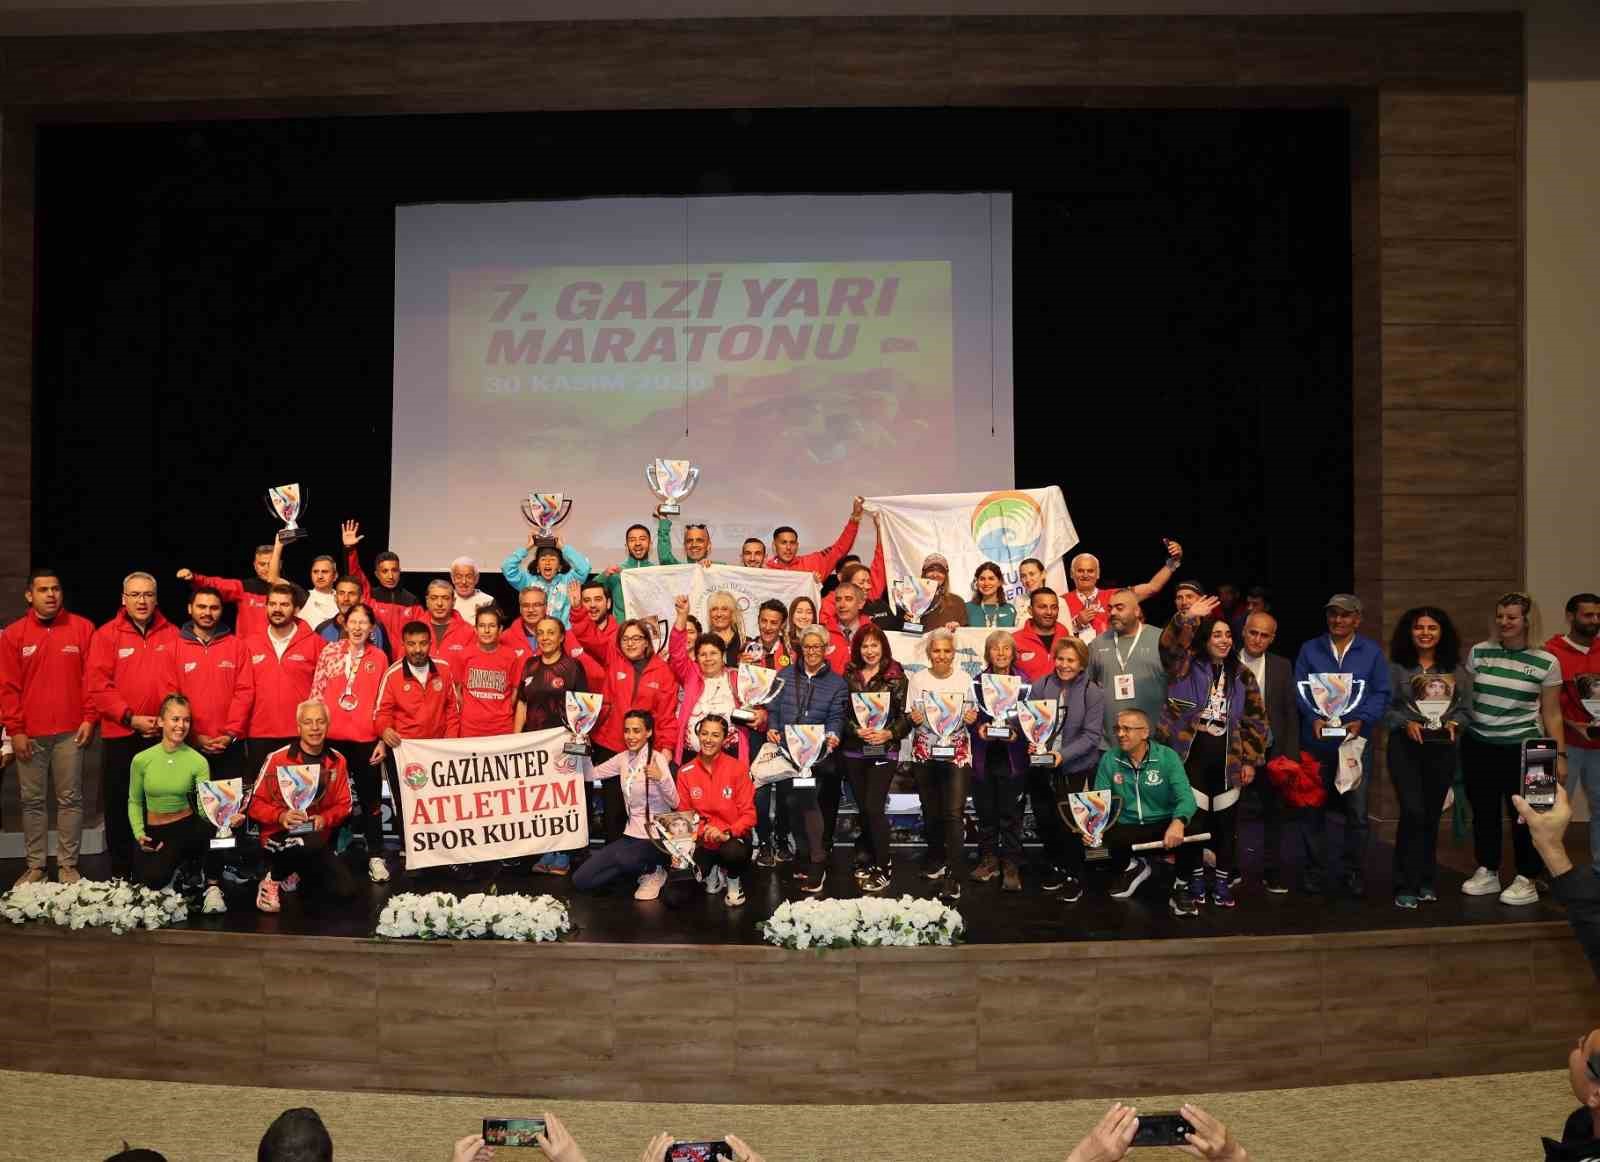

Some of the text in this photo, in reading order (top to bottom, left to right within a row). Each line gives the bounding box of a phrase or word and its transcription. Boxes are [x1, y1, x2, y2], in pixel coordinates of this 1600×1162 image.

[488, 271, 901, 323] 7. GAZİ YARI
[485, 324, 859, 365] MARATONU
[431, 750, 549, 788] GAZİANTEP
[410, 779, 579, 825] ATLETİZM
[412, 809, 580, 852] SPOR KULÜBÜ
